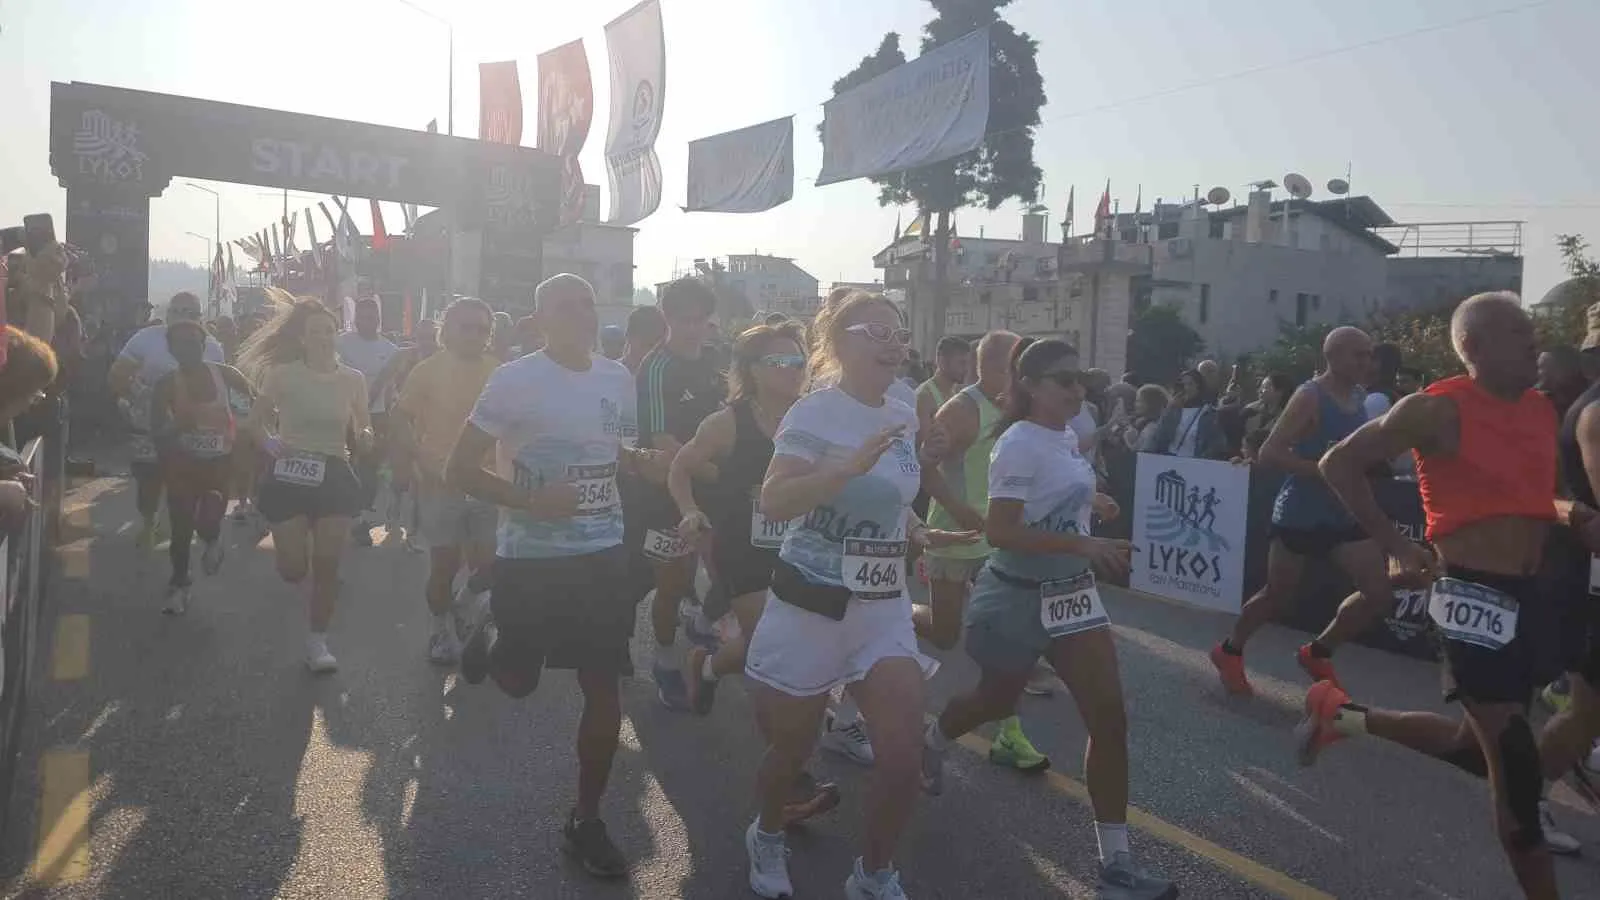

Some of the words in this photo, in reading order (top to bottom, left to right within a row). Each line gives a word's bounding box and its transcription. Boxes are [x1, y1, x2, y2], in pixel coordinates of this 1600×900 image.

[79, 156, 143, 182] LYKOS
[251, 138, 409, 187] START
[284, 460, 319, 477] 11765
[856, 562, 898, 587] 4646
[1148, 542, 1222, 584] LYKOS
[1048, 594, 1093, 623] 10769
[1443, 600, 1503, 635] 10716
